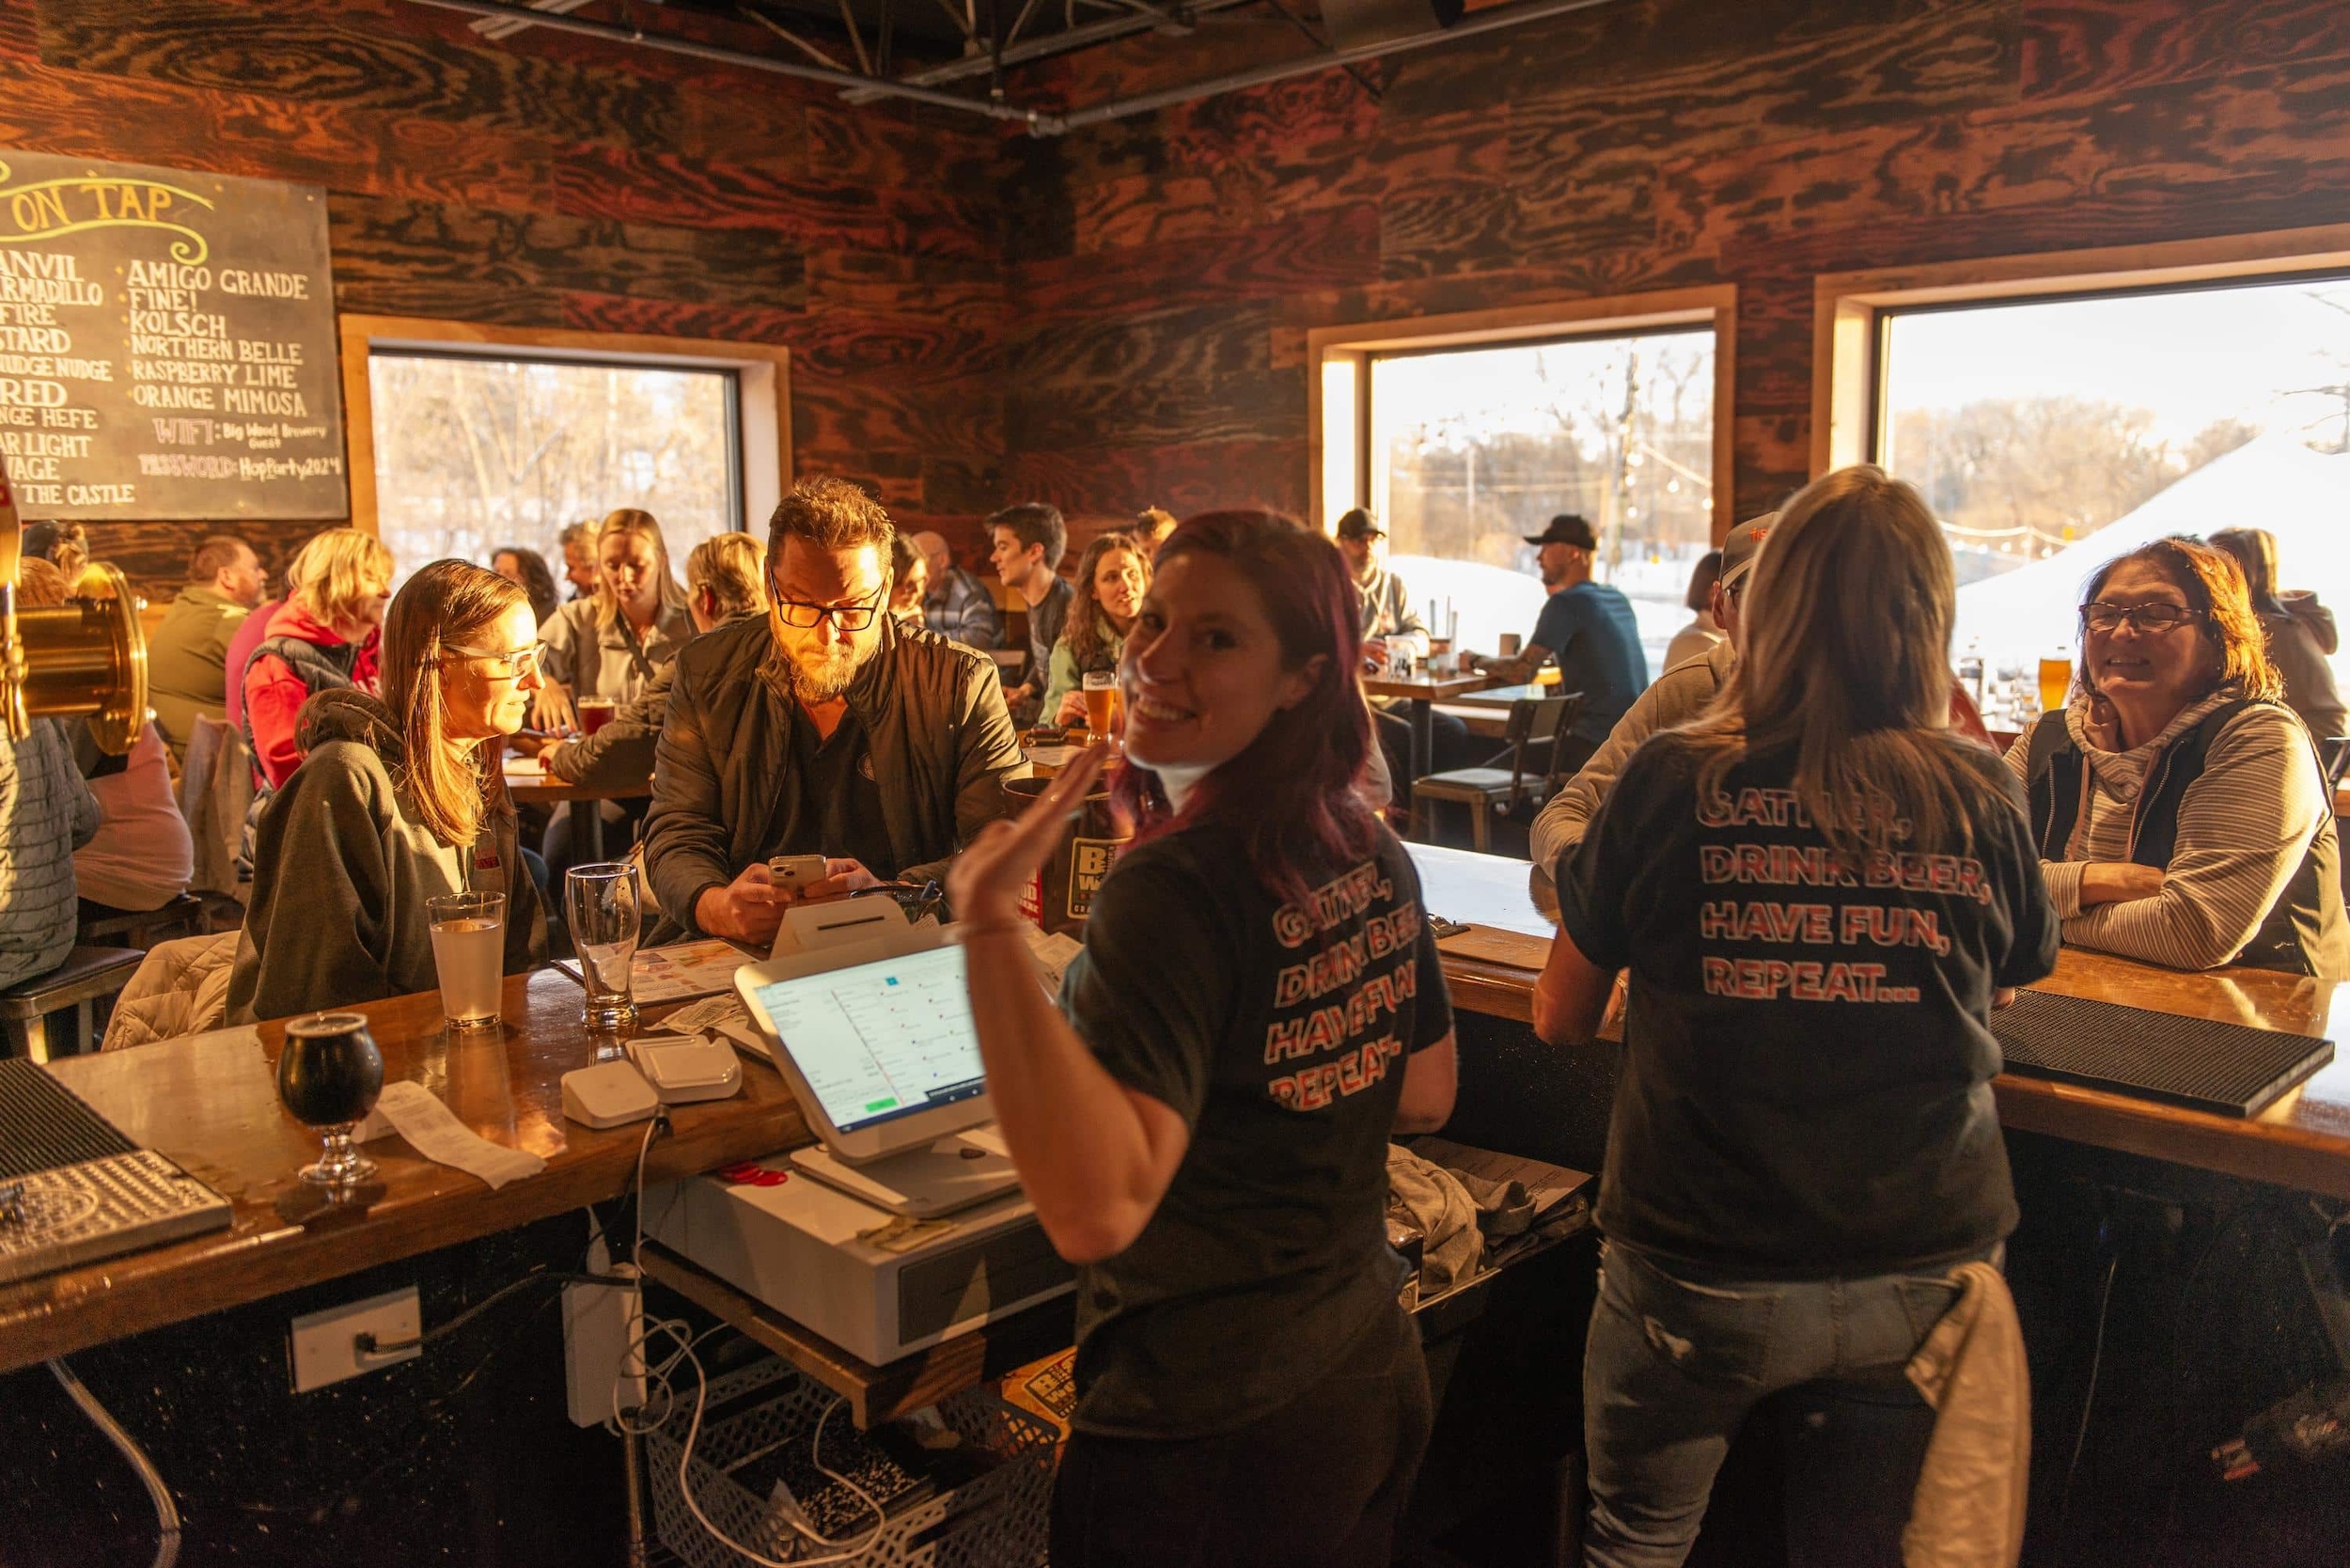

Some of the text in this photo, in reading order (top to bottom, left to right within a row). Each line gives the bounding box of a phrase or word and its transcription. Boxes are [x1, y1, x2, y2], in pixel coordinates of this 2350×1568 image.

[11, 183, 172, 232] ON TAP
[0, 275, 102, 306] RMADILLO
[127, 259, 309, 300] AMIGO GRANDE
[128, 288, 197, 312] FINE!
[129, 309, 227, 338] KOLSCH
[131, 335, 303, 366] NORTHERN BELLE
[55, 356, 114, 383] NUDGE
[132, 360, 298, 389] RASPBERRY LIME
[133, 384, 308, 418] ORANGE MIMOSA
[41, 407, 99, 430] HEFE
[24, 432, 92, 459] LIGHT
[20, 483, 135, 507] THE CASTLE
[1700, 843, 1992, 906] DRINK BEER,
[1700, 901, 1951, 958] HAVE FUN,
[1701, 956, 1921, 1003] REPEAT...
